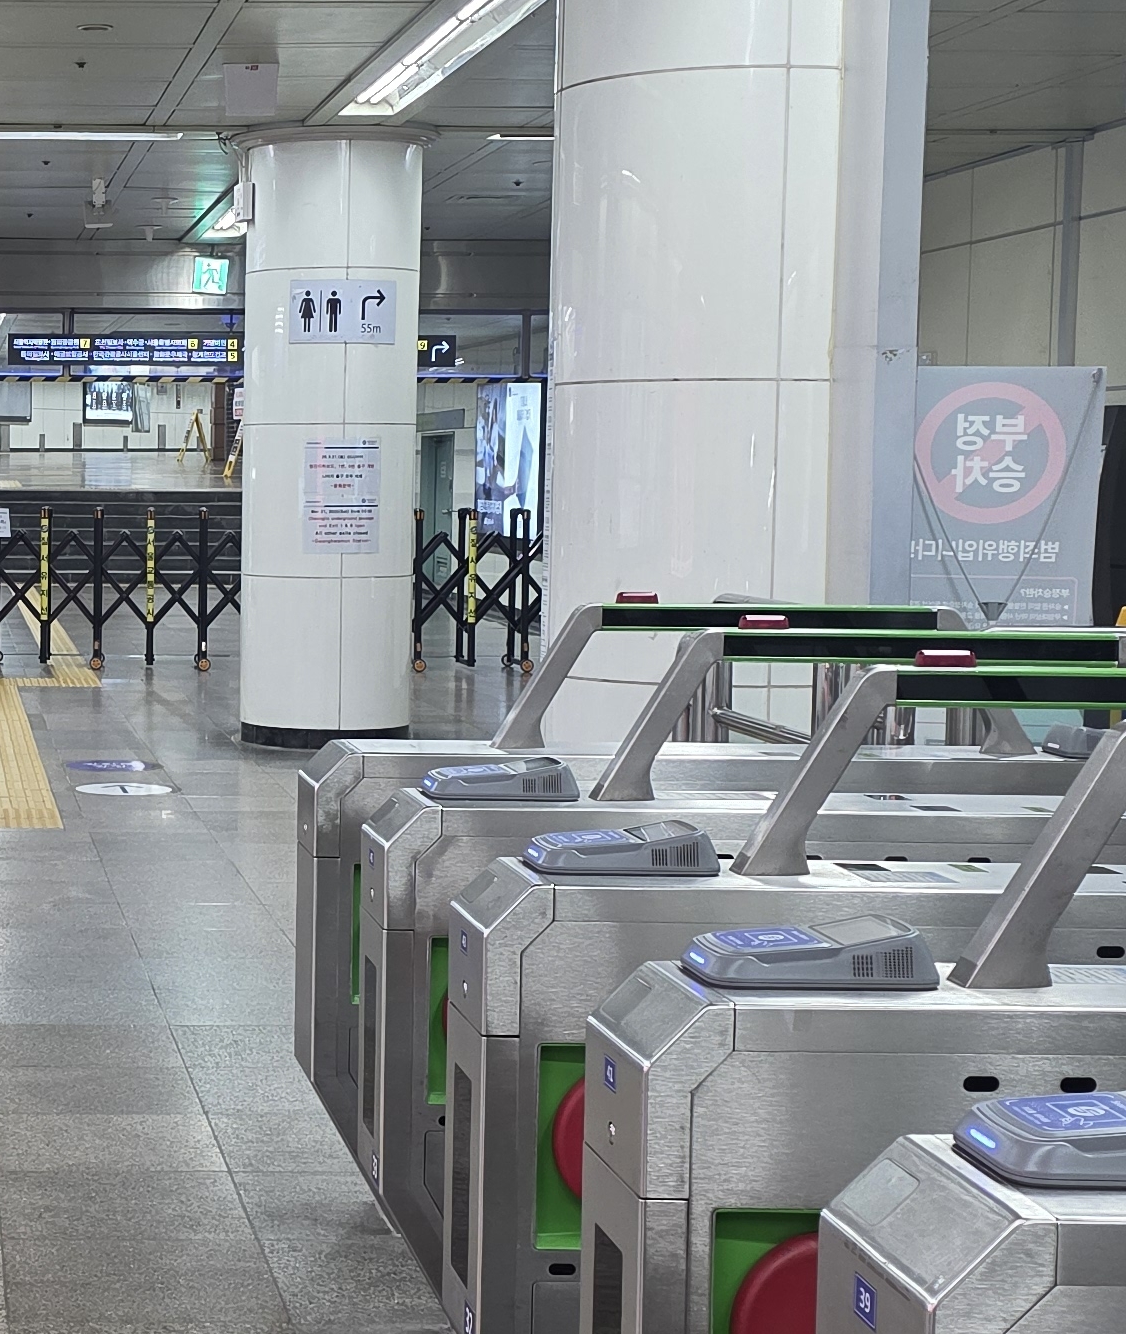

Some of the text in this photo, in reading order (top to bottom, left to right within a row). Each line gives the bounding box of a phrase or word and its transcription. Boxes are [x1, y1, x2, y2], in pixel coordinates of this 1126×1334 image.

[360, 323, 382, 334] 55m
[40, 536, 48, 616] 질서유지선
[146, 538, 154, 617] 서울교통공사
[859, 1287, 871, 1313] 39
